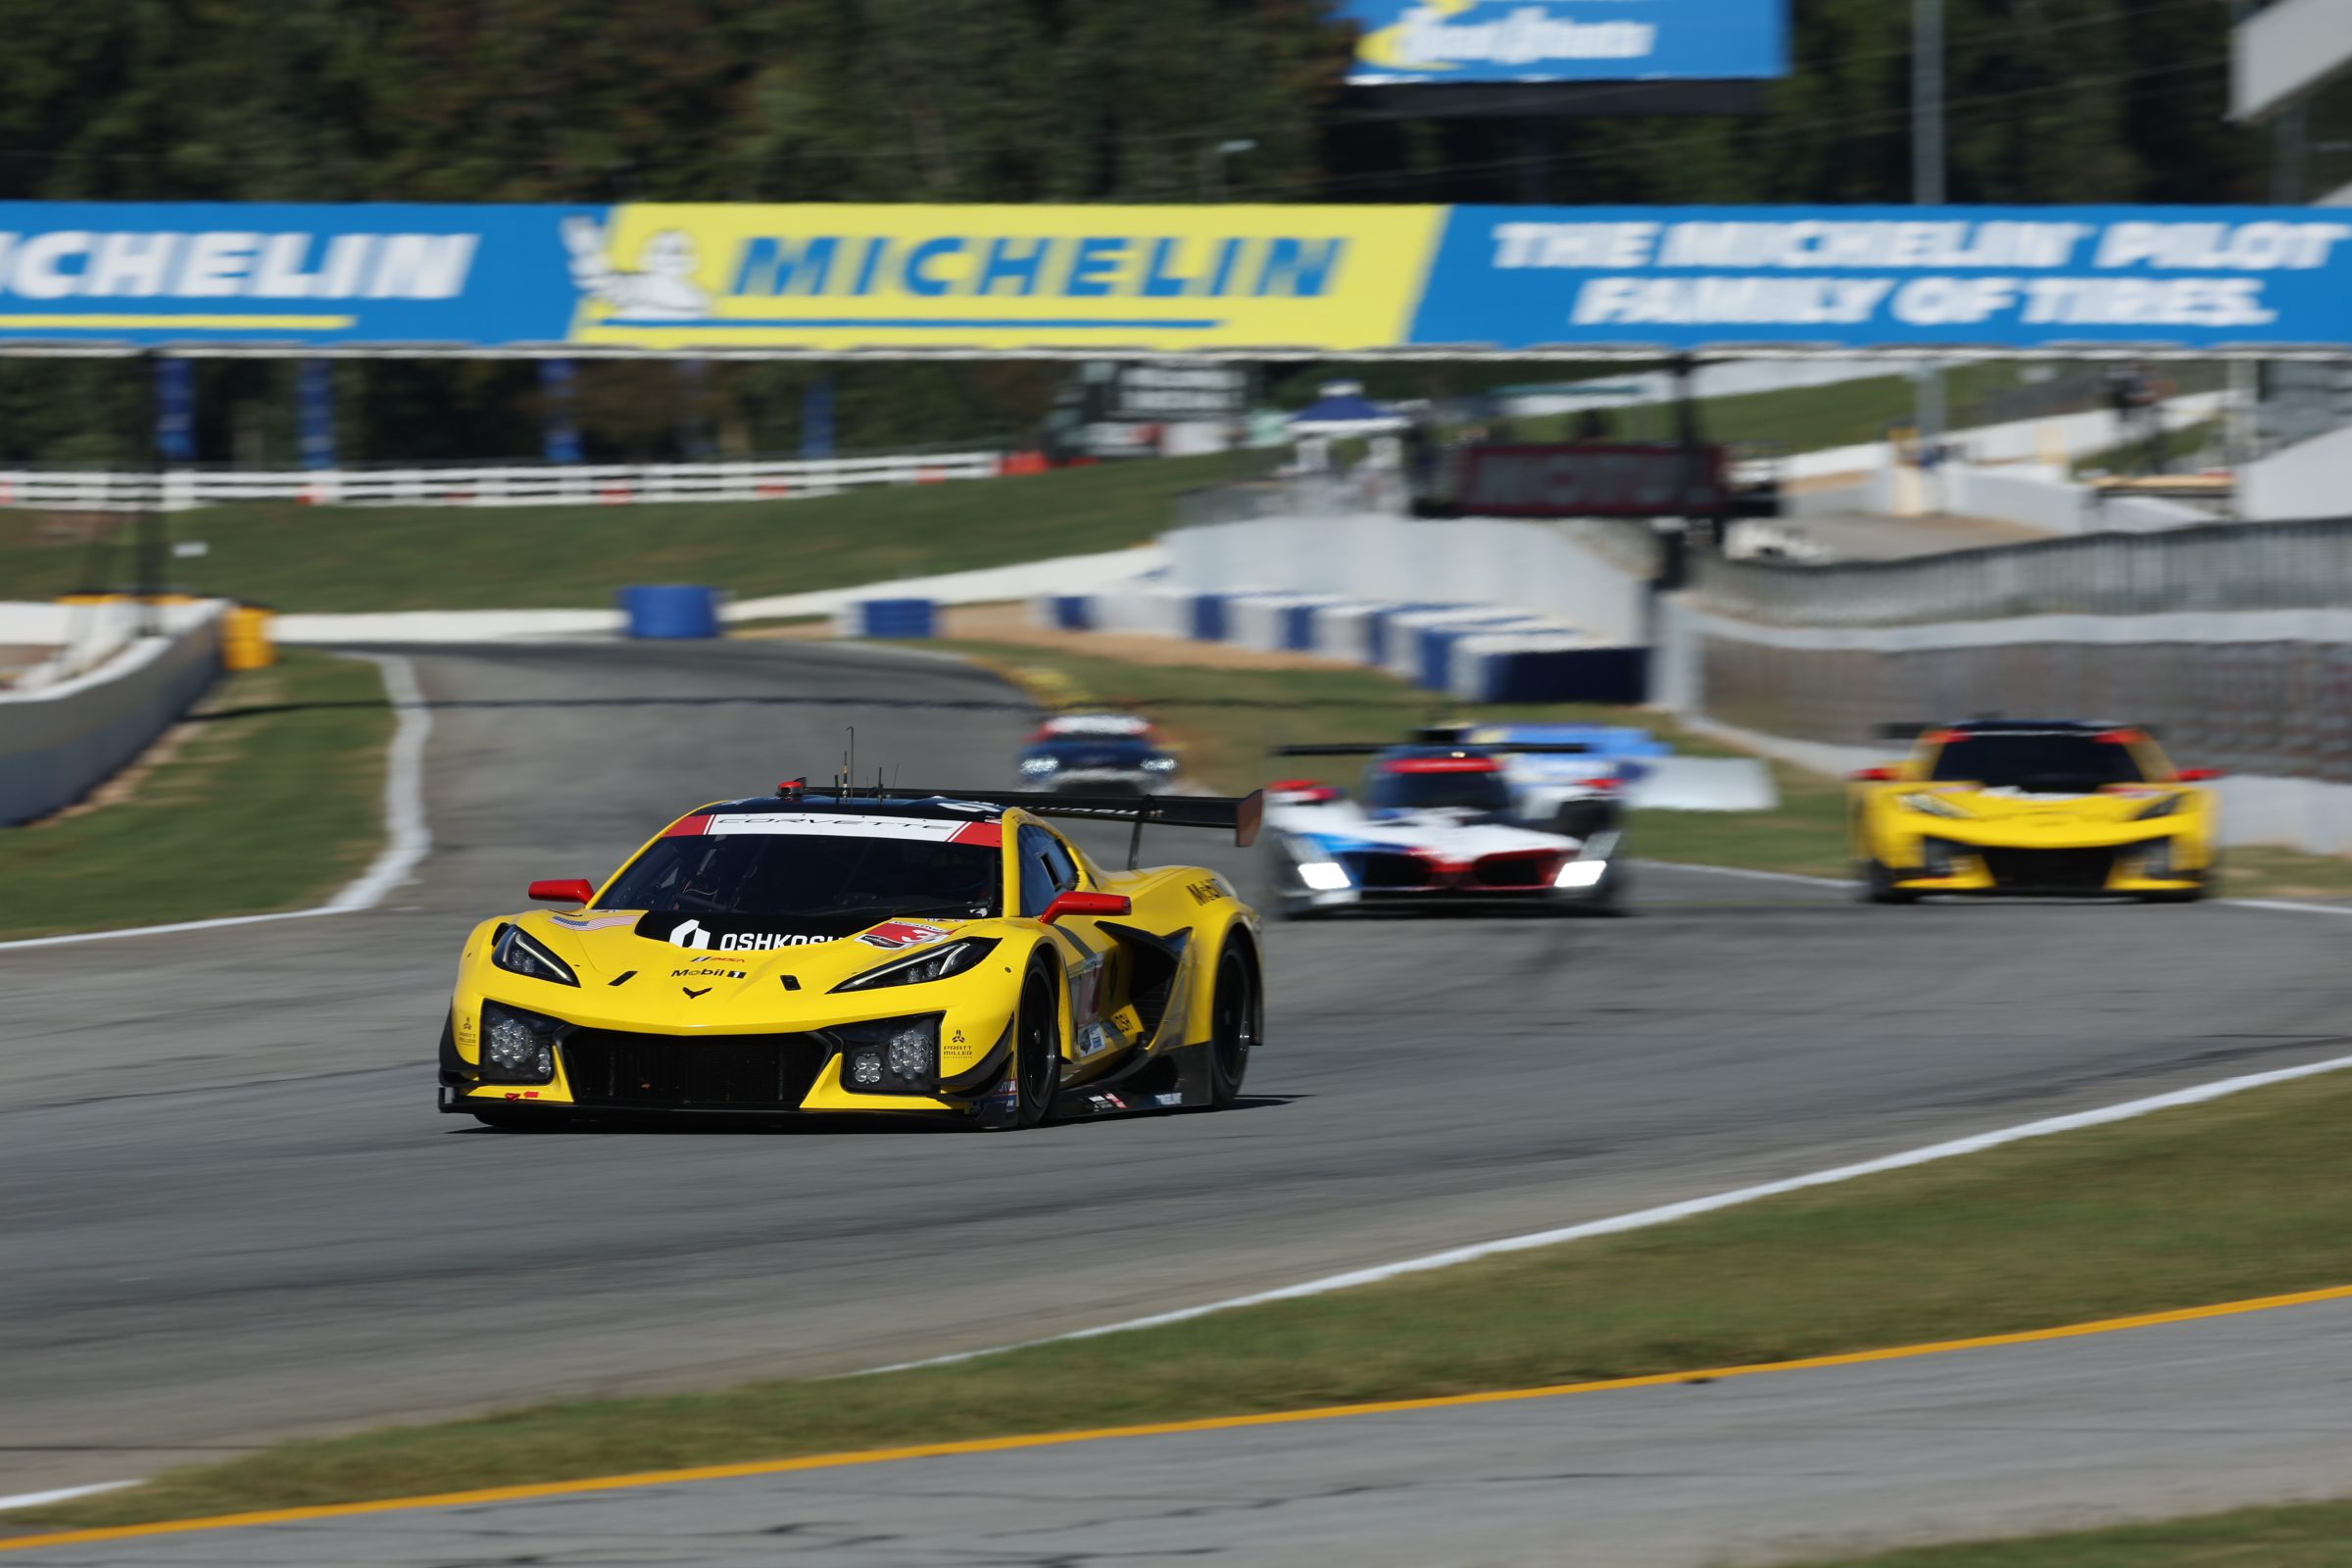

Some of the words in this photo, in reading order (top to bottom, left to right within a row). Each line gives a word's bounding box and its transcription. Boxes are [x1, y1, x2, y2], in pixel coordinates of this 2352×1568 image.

[1492, 221, 1663, 270] THE
[2093, 221, 2352, 270] PILOT
[729, 235, 1346, 298] MICHELIN
[1570, 276, 1898, 325] FAMILY
[1892, 276, 2019, 325] OF
[717, 817, 954, 830] CORVETTE
[720, 933, 845, 952] OSHKO
[671, 968, 725, 978] Mobil
